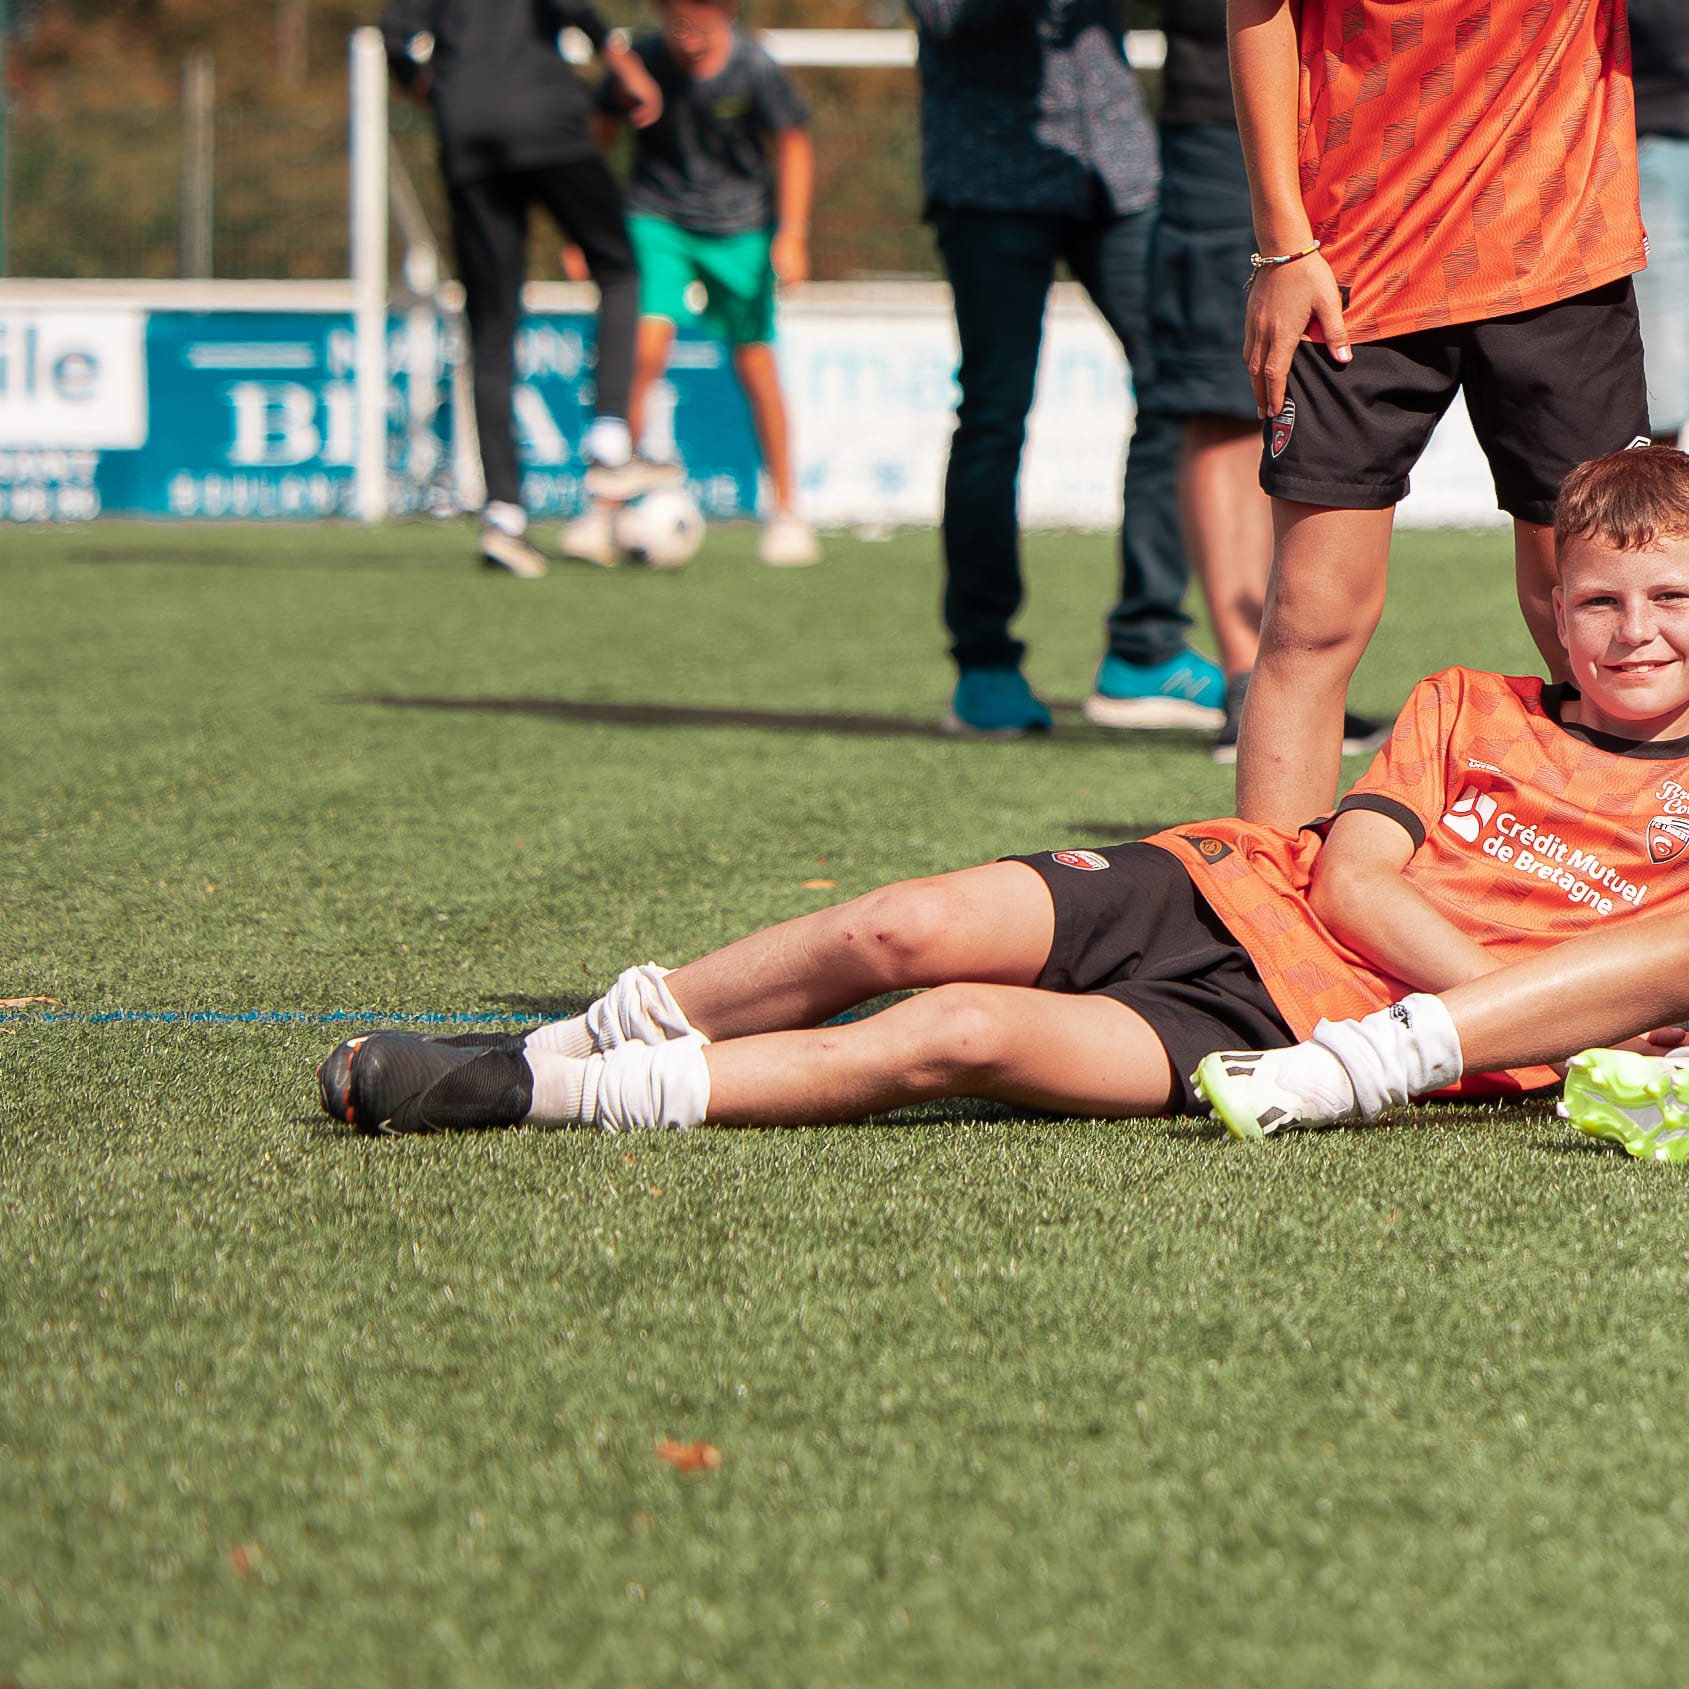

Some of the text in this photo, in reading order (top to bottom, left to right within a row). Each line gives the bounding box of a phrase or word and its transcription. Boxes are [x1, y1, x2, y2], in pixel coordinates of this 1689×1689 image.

[1483, 836, 1613, 916] de Bretagne
[1496, 813, 1648, 906] Crédit Mutuel
